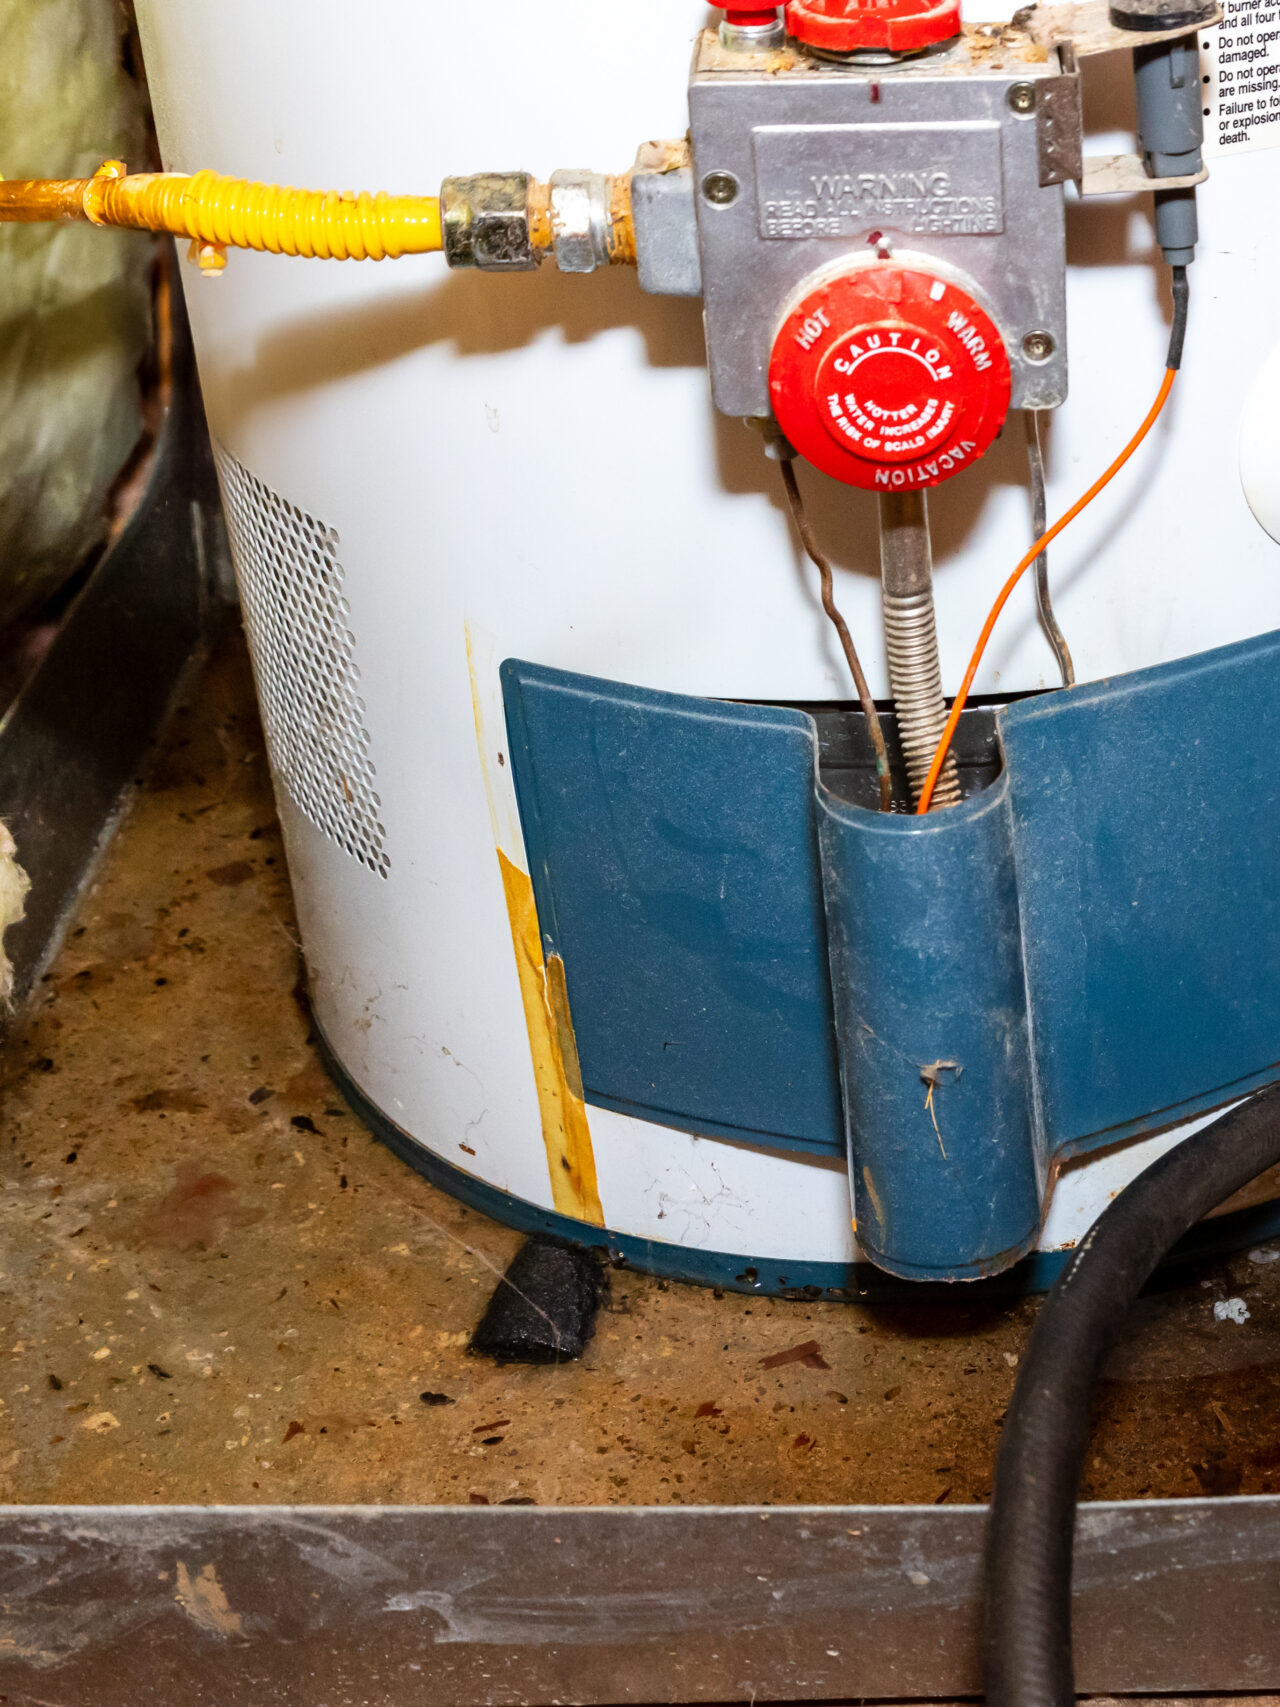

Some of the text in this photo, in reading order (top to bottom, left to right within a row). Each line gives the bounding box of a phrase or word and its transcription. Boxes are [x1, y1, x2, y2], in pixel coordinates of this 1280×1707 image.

[1228, 0, 1261, 13] burner
[1219, 16, 1237, 29] and
[1241, 14, 1252, 26] all
[1255, 12, 1276, 24] four
[1219, 37, 1233, 49] Do
[1237, 33, 1253, 46] not
[1219, 47, 1269, 64] damaged.
[1219, 70, 1233, 82] Do
[1237, 66, 1253, 79] not
[1219, 79, 1280, 98] are missing.
[1219, 101, 1254, 116] Failure
[1256, 98, 1266, 109] to
[1219, 120, 1230, 131] or
[1219, 130, 1250, 145] death.
[810, 172, 950, 199] WARNING
[765, 196, 997, 217] READ ALL INSTRUCTIONS
[766, 214, 998, 235] BEFORE LIGHTING
[794, 306, 831, 350] HOT
[946, 311, 993, 372] WARM
[833, 332, 953, 380] CAUTION
[844, 393, 939, 437] WATER INCREASES
[863, 400, 917, 421] HOTTER
[827, 393, 955, 452] THE RISK OF SCALD INJURY
[874, 440, 977, 486] VACATION
